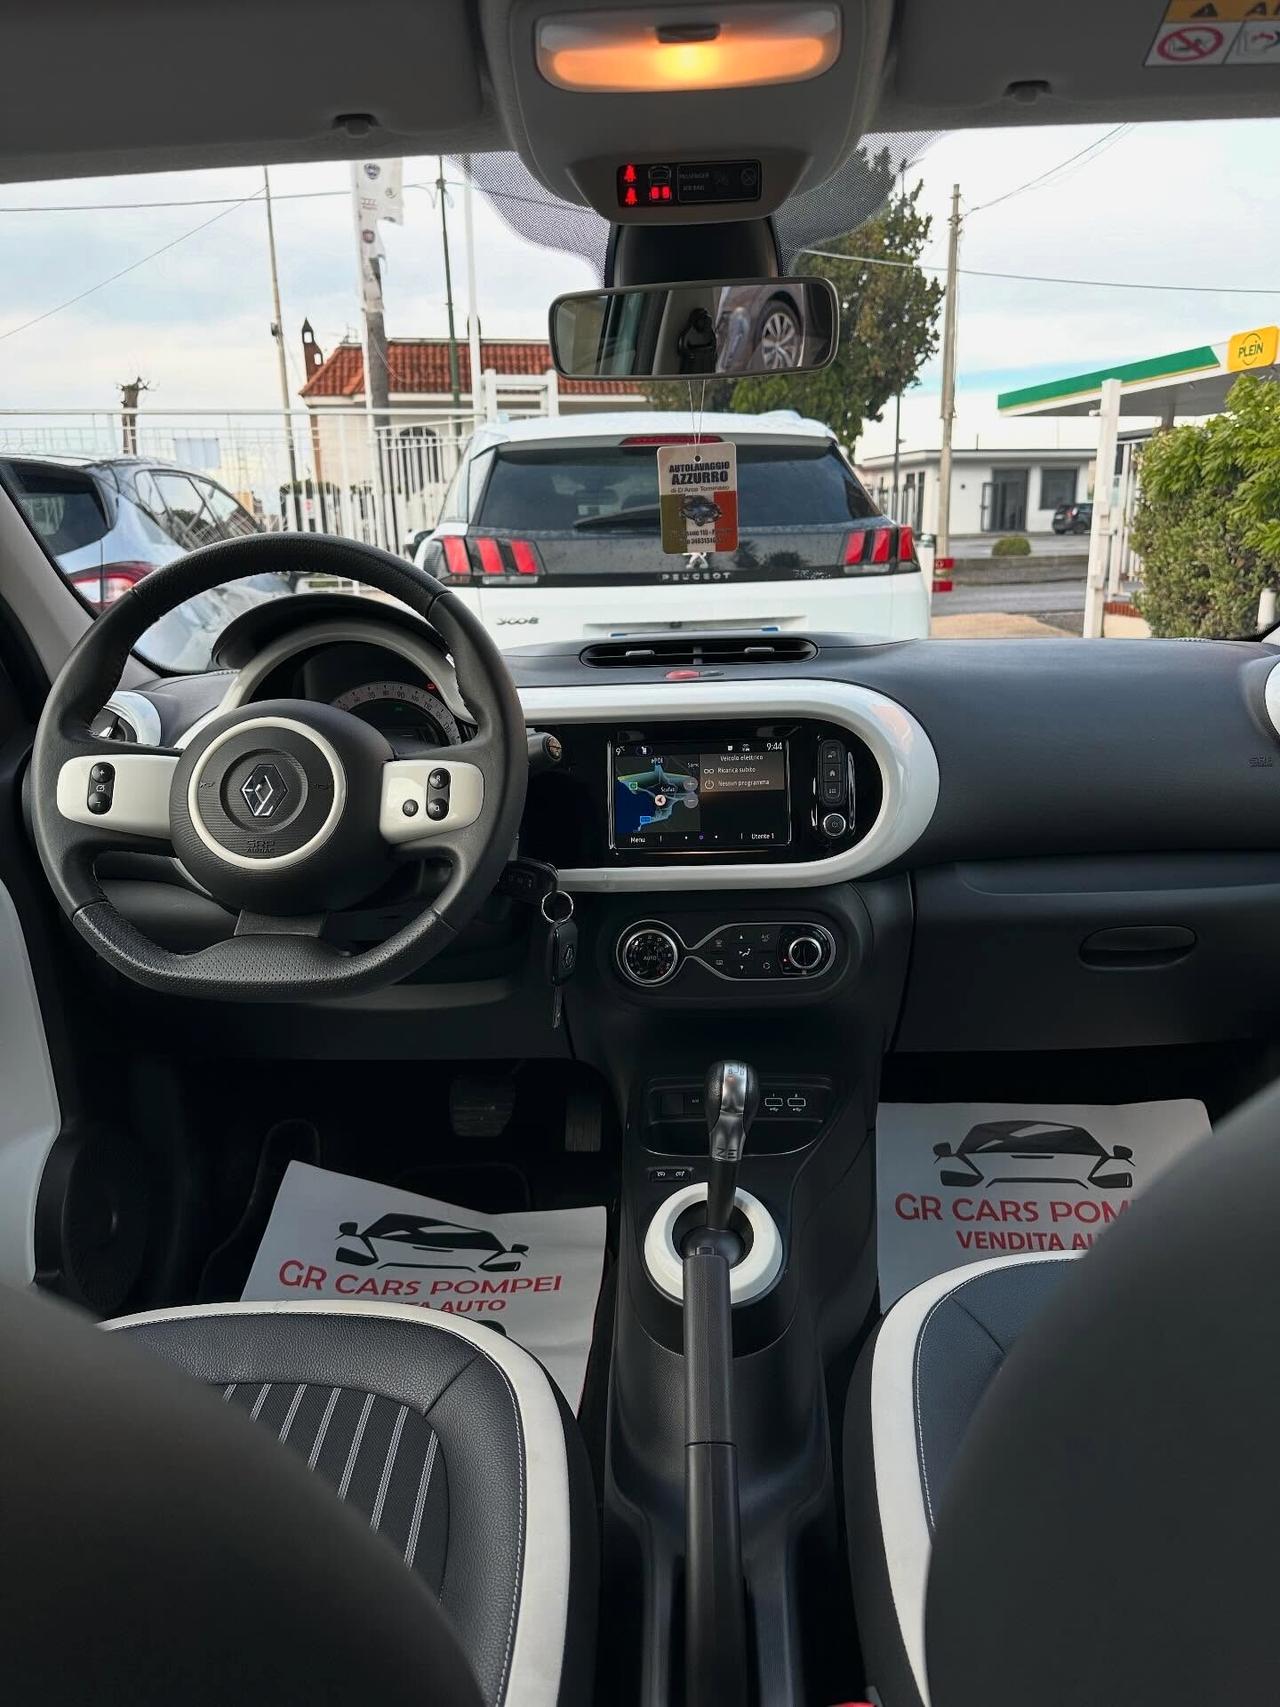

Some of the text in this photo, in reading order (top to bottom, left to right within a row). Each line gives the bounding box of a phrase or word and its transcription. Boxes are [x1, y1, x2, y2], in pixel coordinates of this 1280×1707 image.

[669, 461, 729, 473] AUTOLAVAGGIO
[672, 471, 728, 485] AZZURRO
[662, 572, 731, 581] PEUGEOT
[496, 616, 540, 626] 3008
[766, 742, 783, 751] 9:44
[738, 779, 770, 788] programma
[751, 832, 770, 840] Utente
[895, 1193, 943, 1220] GR
[952, 1198, 1039, 1222] CARS
[956, 1231, 1065, 1250] VENDITA
[279, 1260, 562, 1295] GR CARS POMPEI
[440, 1299, 506, 1313] AUTO
